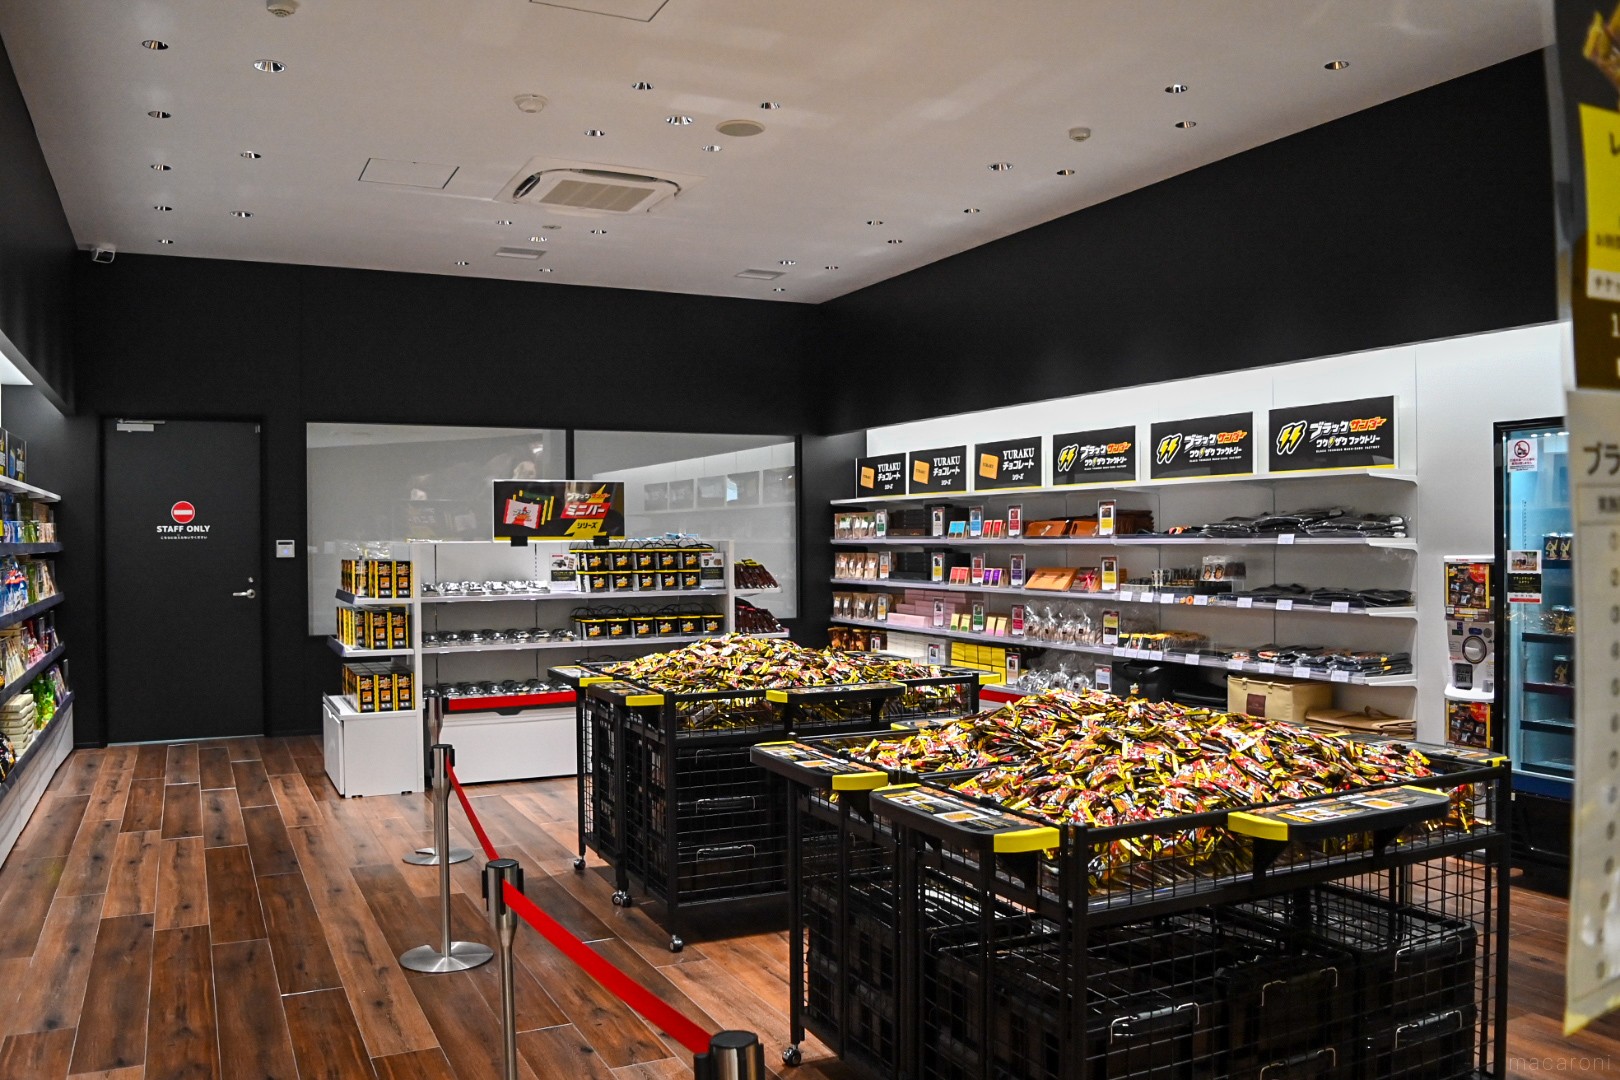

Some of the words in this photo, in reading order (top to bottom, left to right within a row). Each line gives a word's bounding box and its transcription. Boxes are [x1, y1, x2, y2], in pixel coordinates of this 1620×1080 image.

[1002, 448, 1035, 460] YURAKU
[877, 462, 901, 472] YURAKU
[933, 456, 961, 467] YURAKU
[1002, 459, 1035, 471] チョコレート
[933, 466, 960, 477] チョコレート
[566, 504, 605, 516] ミニバー
[156, 525, 184, 533] STAFF
[186, 525, 211, 533] ONLY
